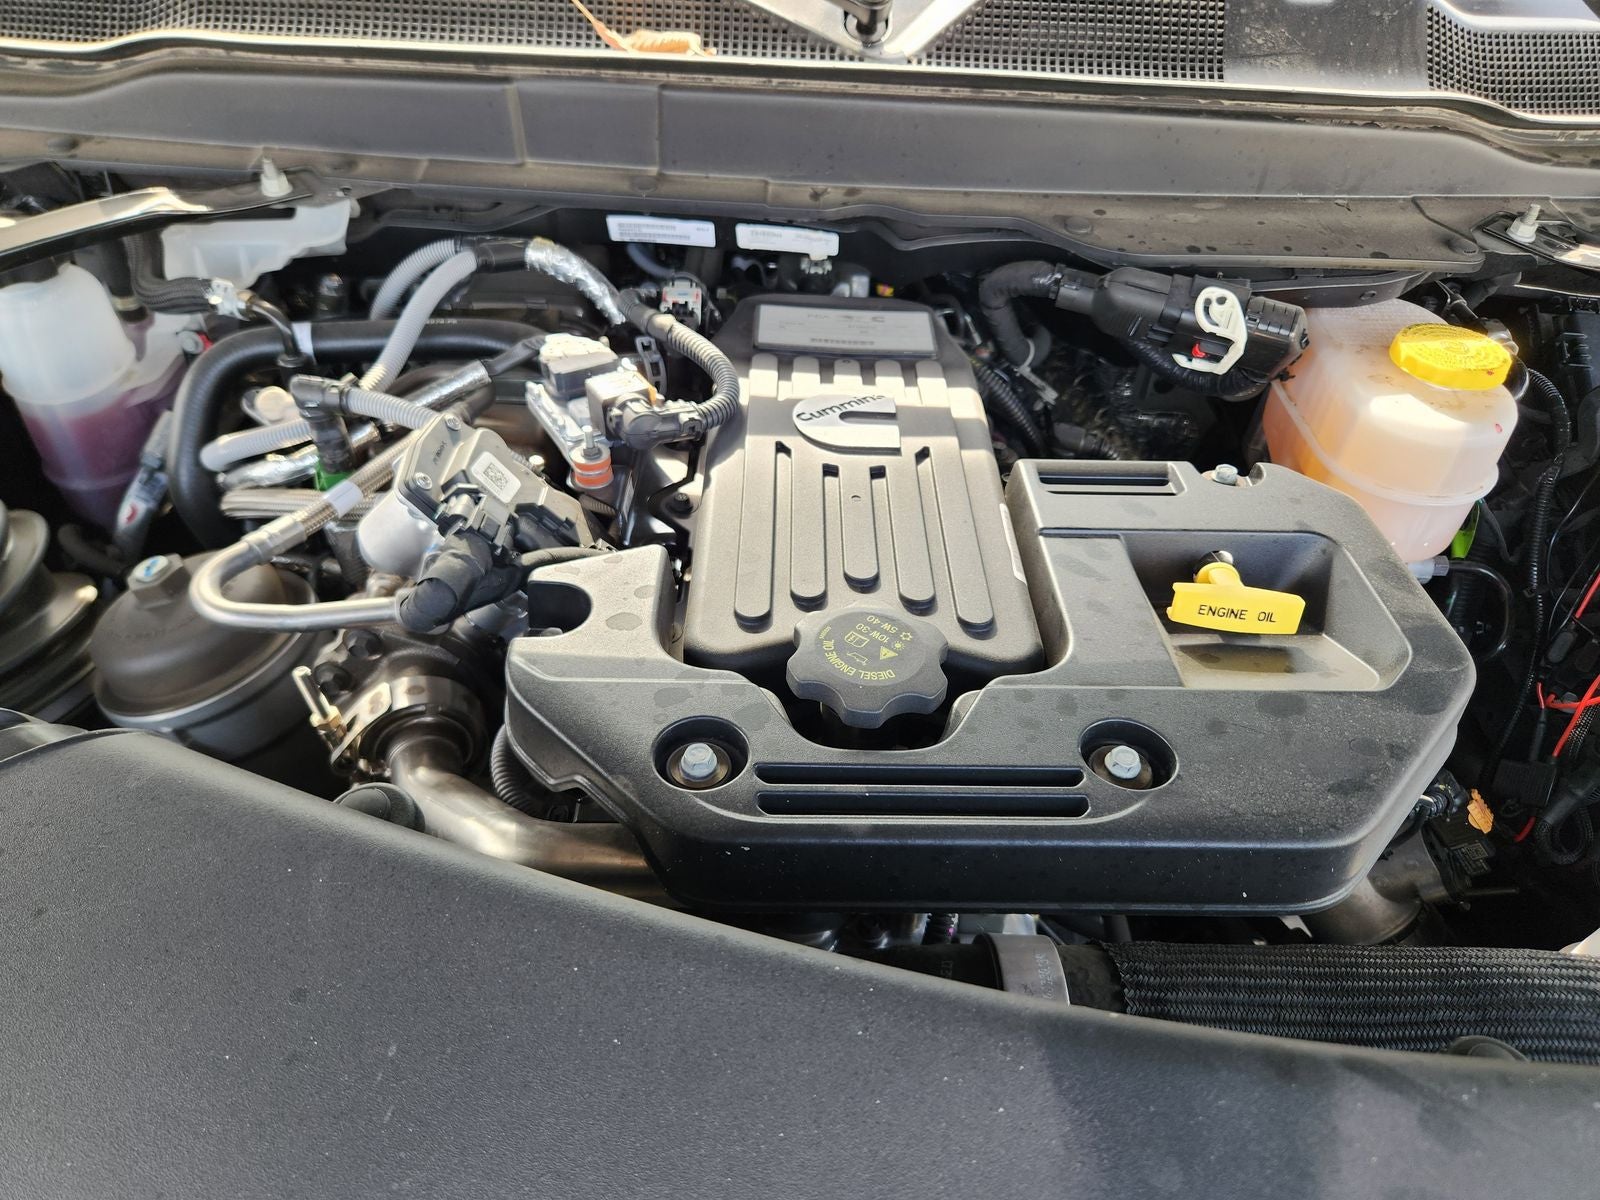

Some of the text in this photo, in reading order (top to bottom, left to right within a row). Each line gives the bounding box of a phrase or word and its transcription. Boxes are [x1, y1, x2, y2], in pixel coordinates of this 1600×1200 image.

[1198, 605, 1277, 623] ENGINE OIL
[856, 623, 889, 643] 10W-30
[866, 615, 898, 633] 5W-40
[822, 639, 896, 680] DIESEL ENGINE OIL
